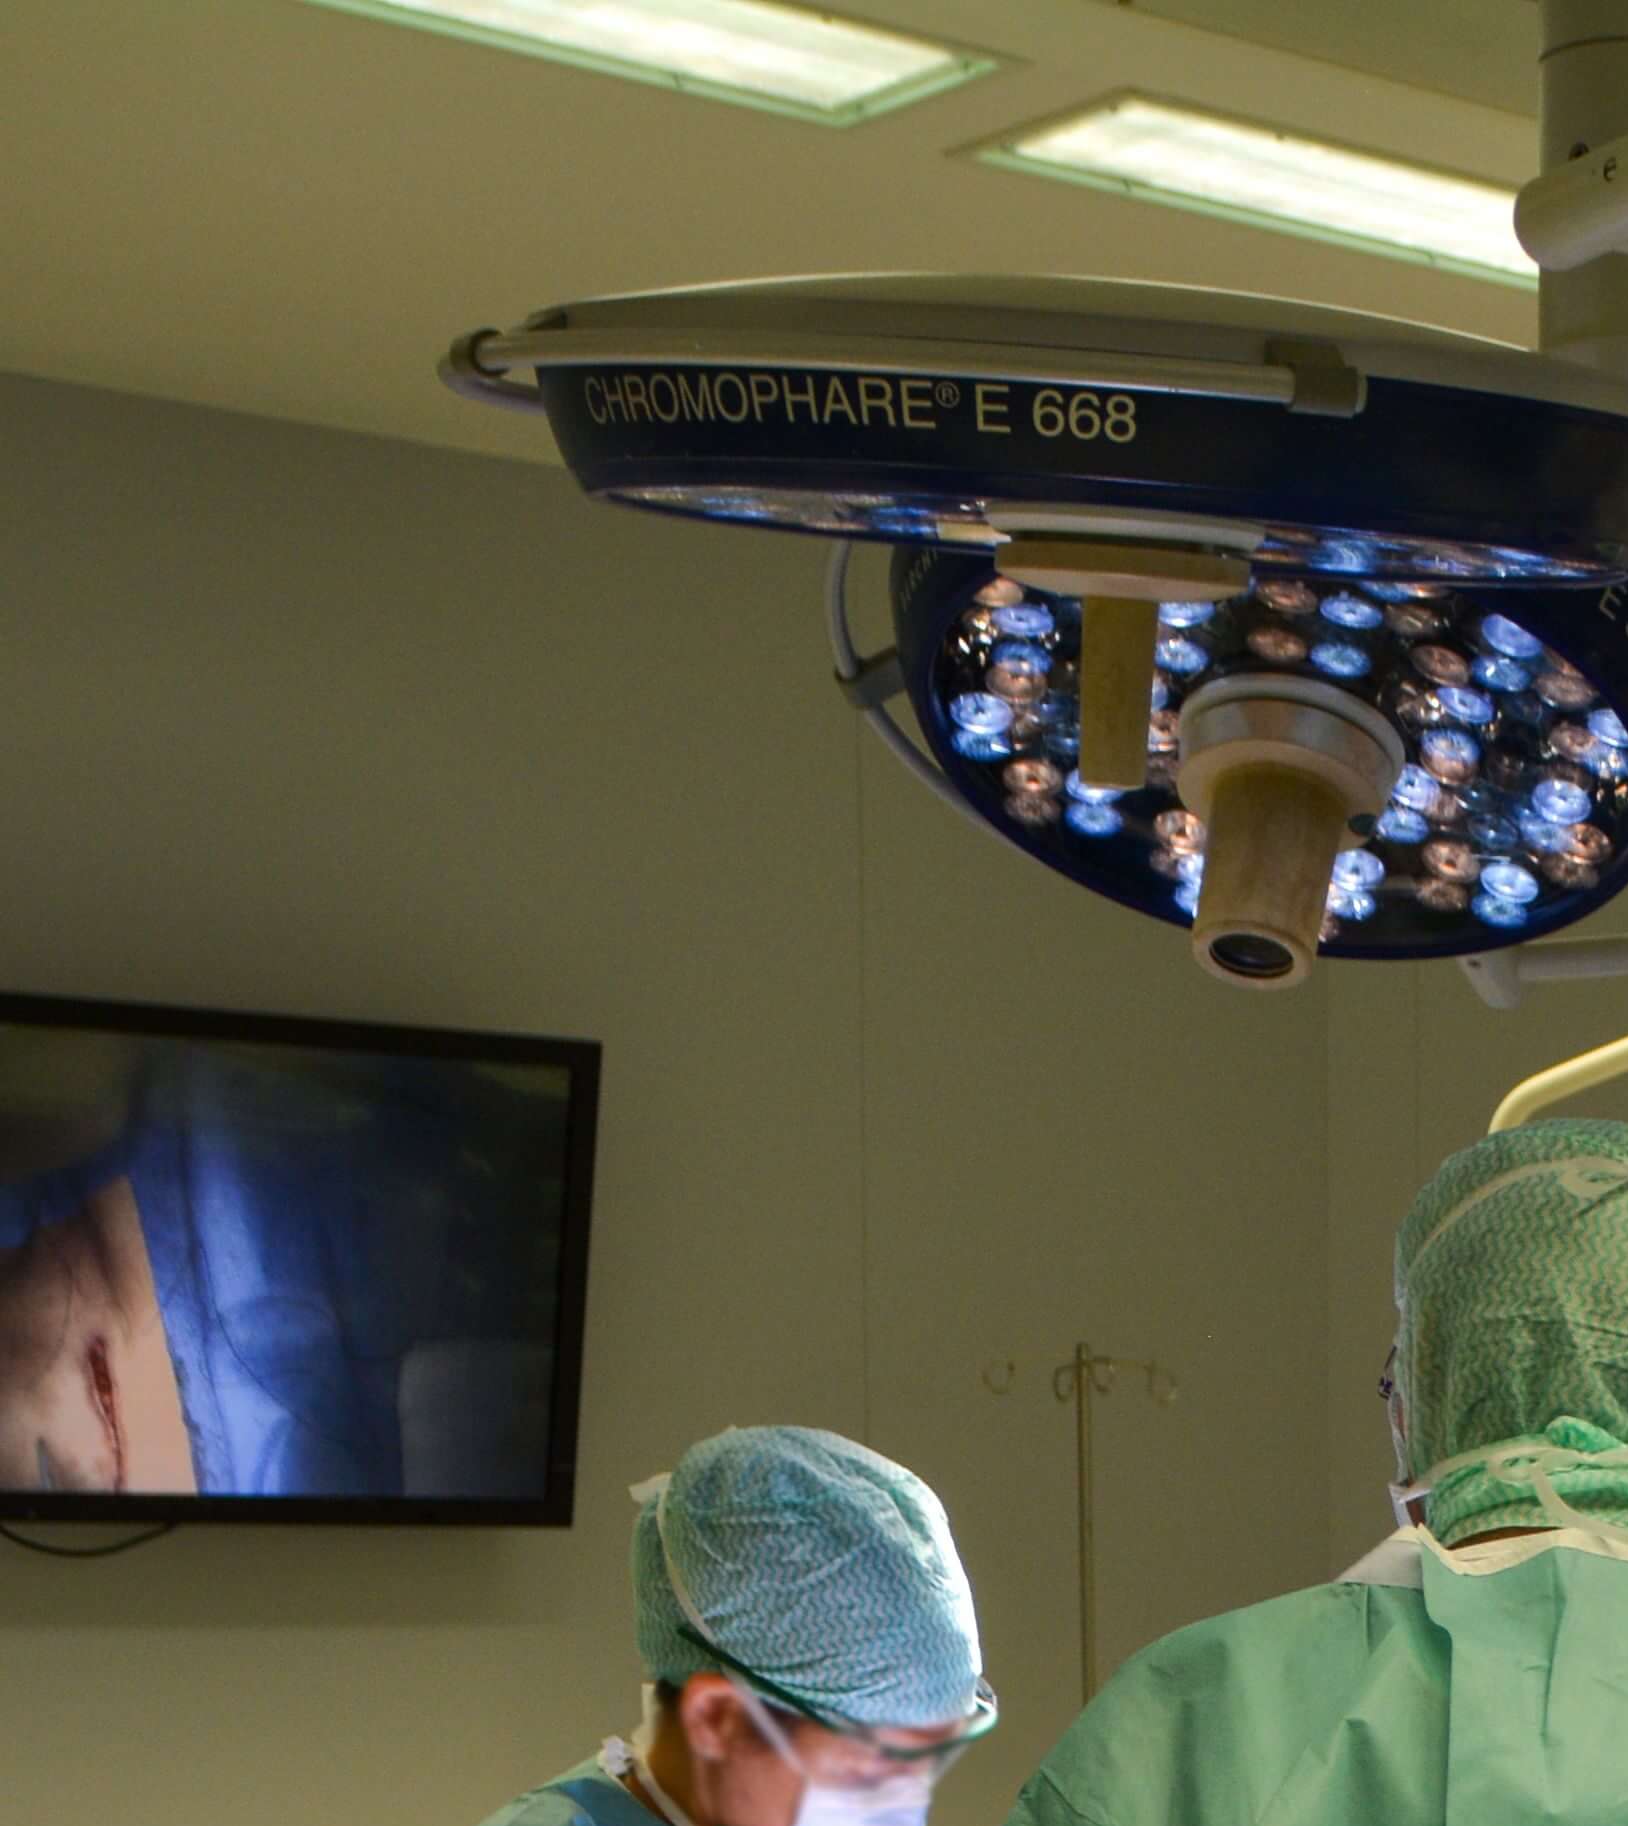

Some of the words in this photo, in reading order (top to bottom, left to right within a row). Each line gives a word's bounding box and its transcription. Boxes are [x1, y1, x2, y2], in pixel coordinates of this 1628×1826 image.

[974, 383, 1012, 434] E
[1031, 388, 1138, 444] 668
[1599, 586, 1628, 621] E
